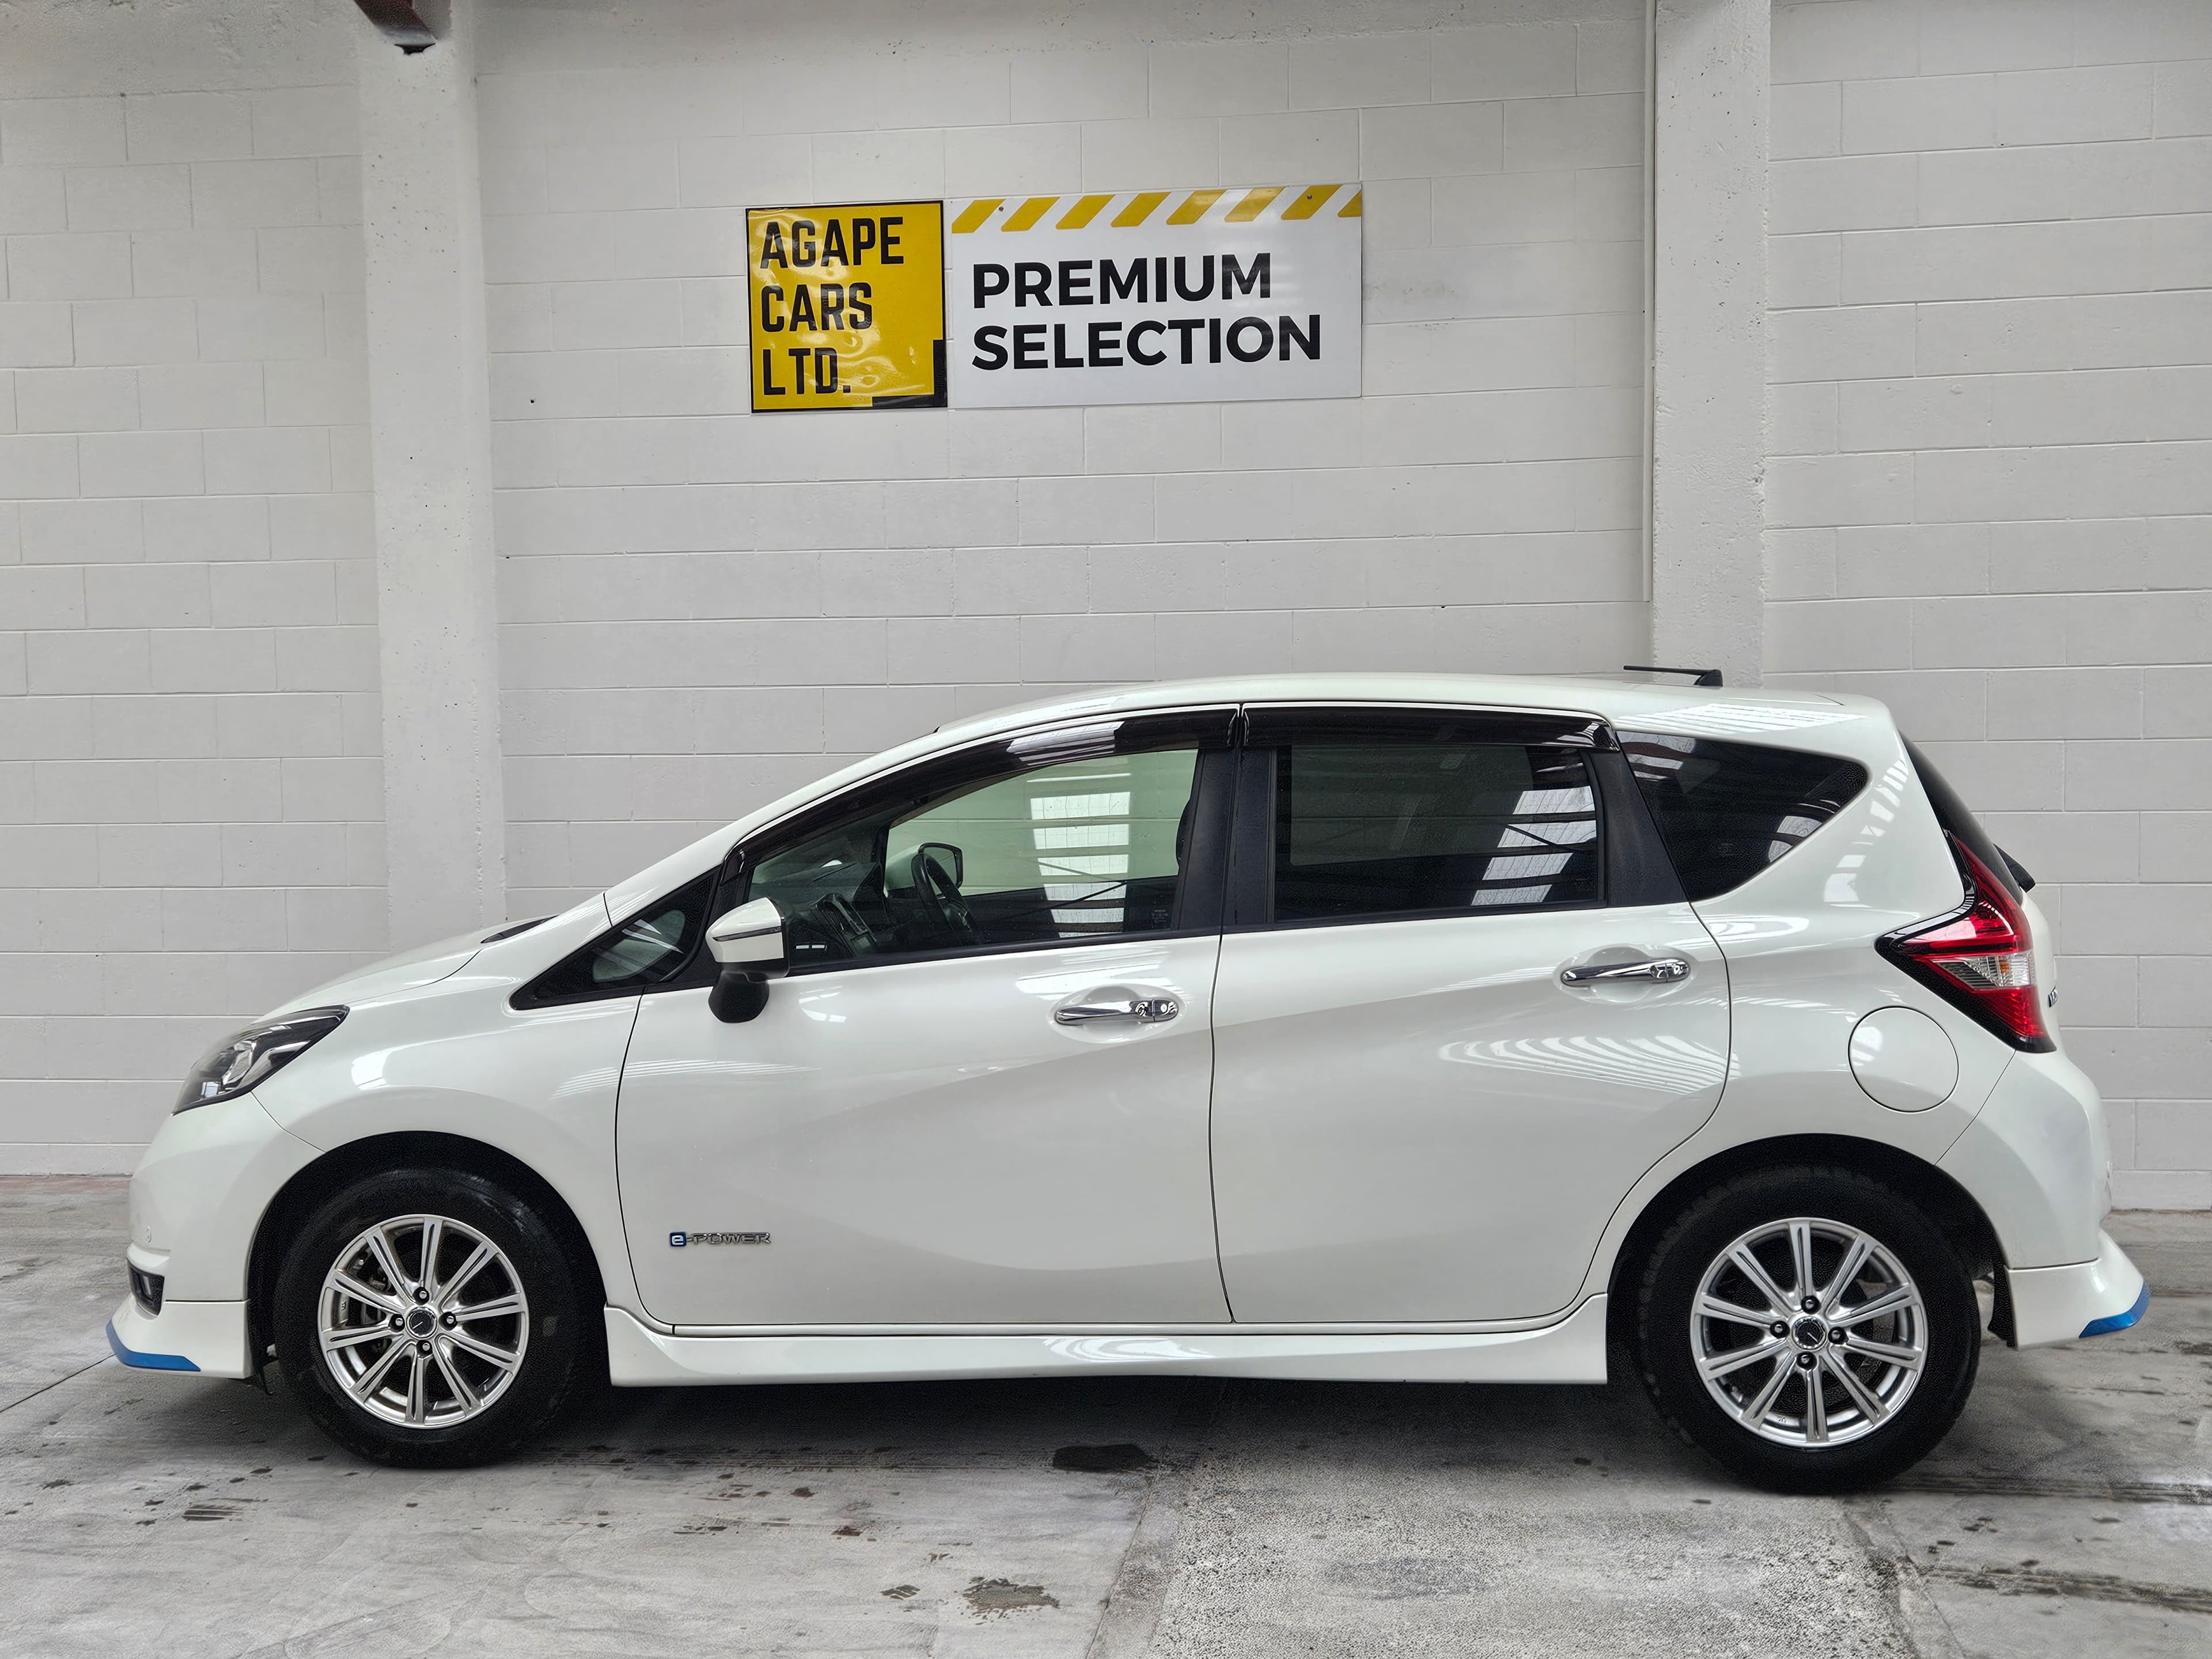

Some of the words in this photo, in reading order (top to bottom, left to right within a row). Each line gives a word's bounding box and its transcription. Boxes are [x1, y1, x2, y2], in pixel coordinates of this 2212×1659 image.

[760, 216, 904, 269] AGAPE
[761, 282, 873, 332] CARS
[974, 252, 1271, 309] PREMIUM
[972, 314, 1320, 370] SELECTION
[763, 347, 851, 396] LTD.
